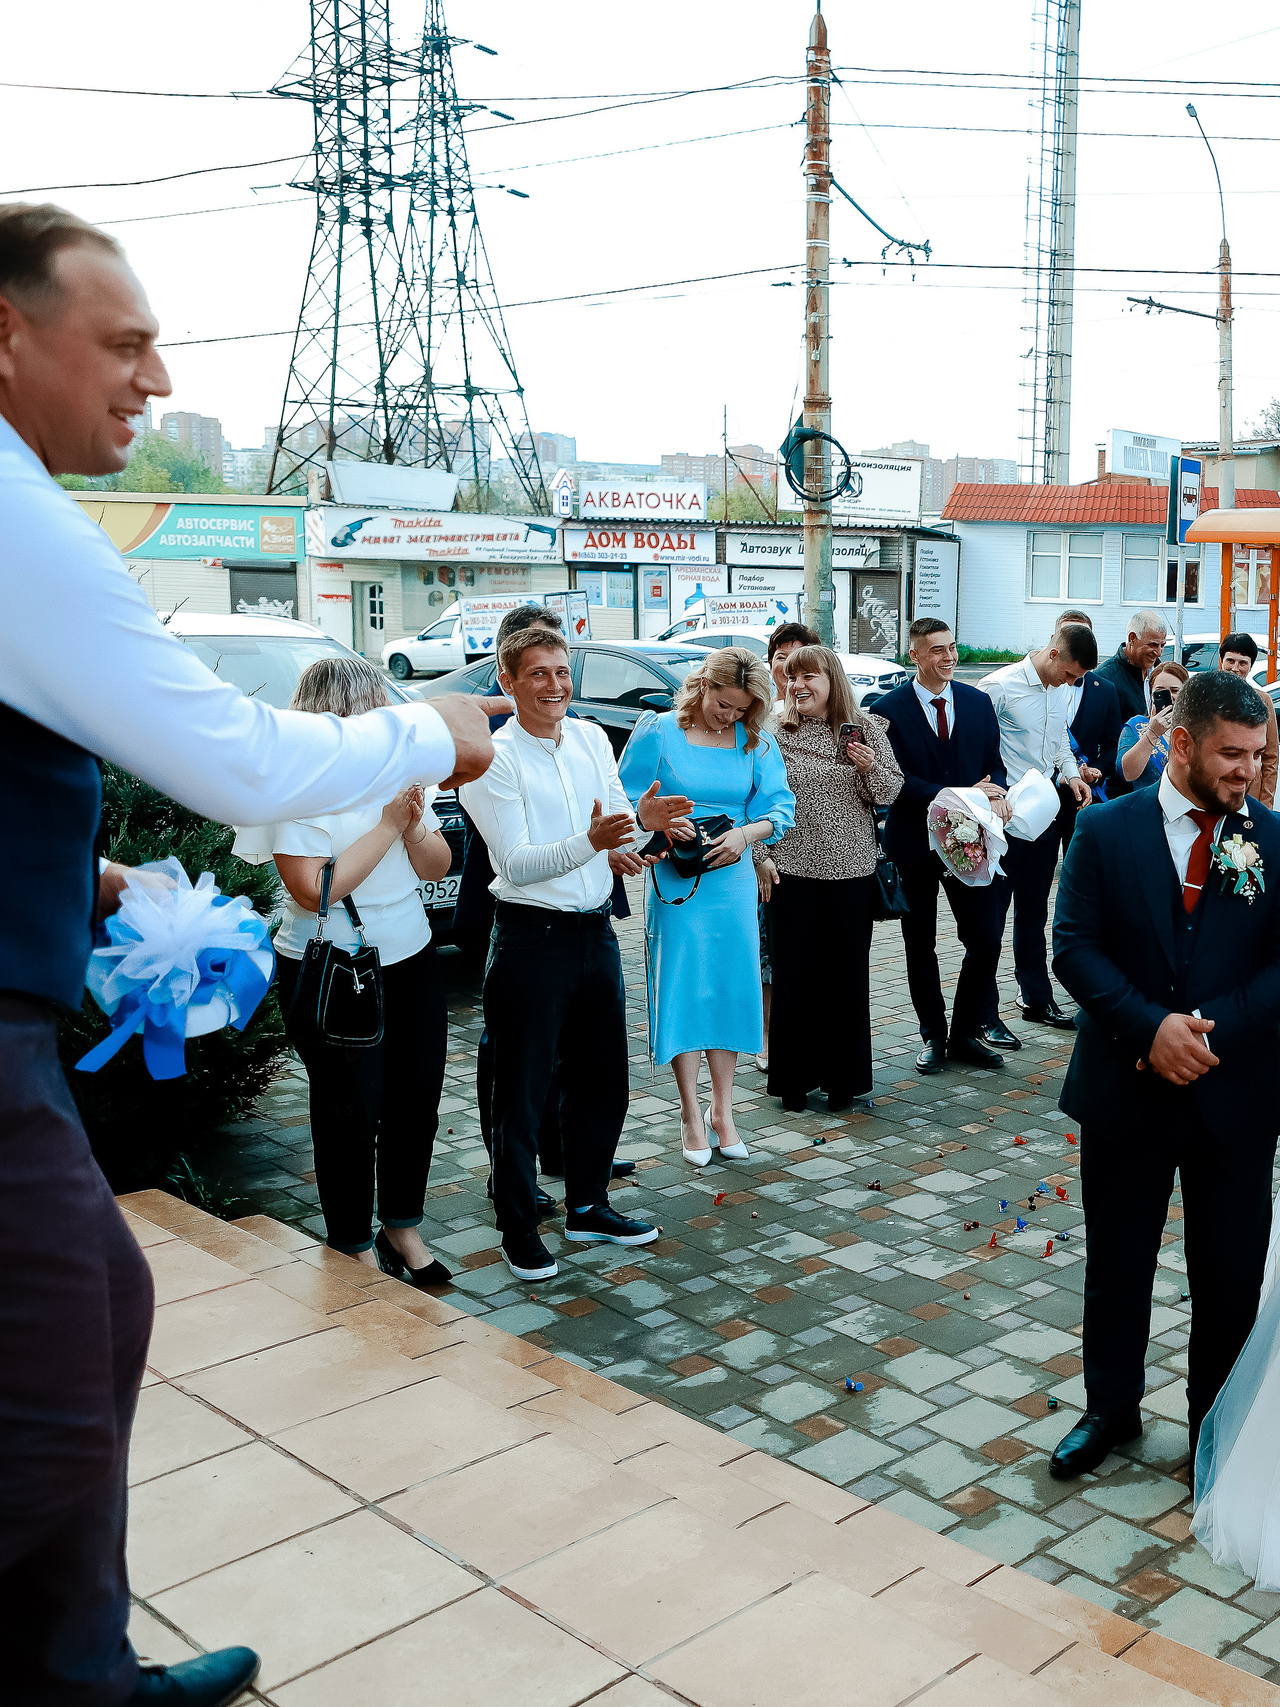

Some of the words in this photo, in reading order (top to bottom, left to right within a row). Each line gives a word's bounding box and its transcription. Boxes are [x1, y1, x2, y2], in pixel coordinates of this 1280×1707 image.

[583, 491, 702, 510] АКВАТОЧКА
[176, 518, 255, 531] АВТОСЕРВИС
[160, 534, 255, 548] АВТОЗАПЧАСТИ
[584, 531, 627, 550] ДОМ
[633, 532, 696, 552] ВОДЫ
[740, 541, 793, 557] Автозвук
[738, 574, 765, 582] Подбор
[717, 602, 737, 611] ДОМ
[739, 601, 767, 609] ВОДЫ
[719, 615, 749, 625] 303-21-23
